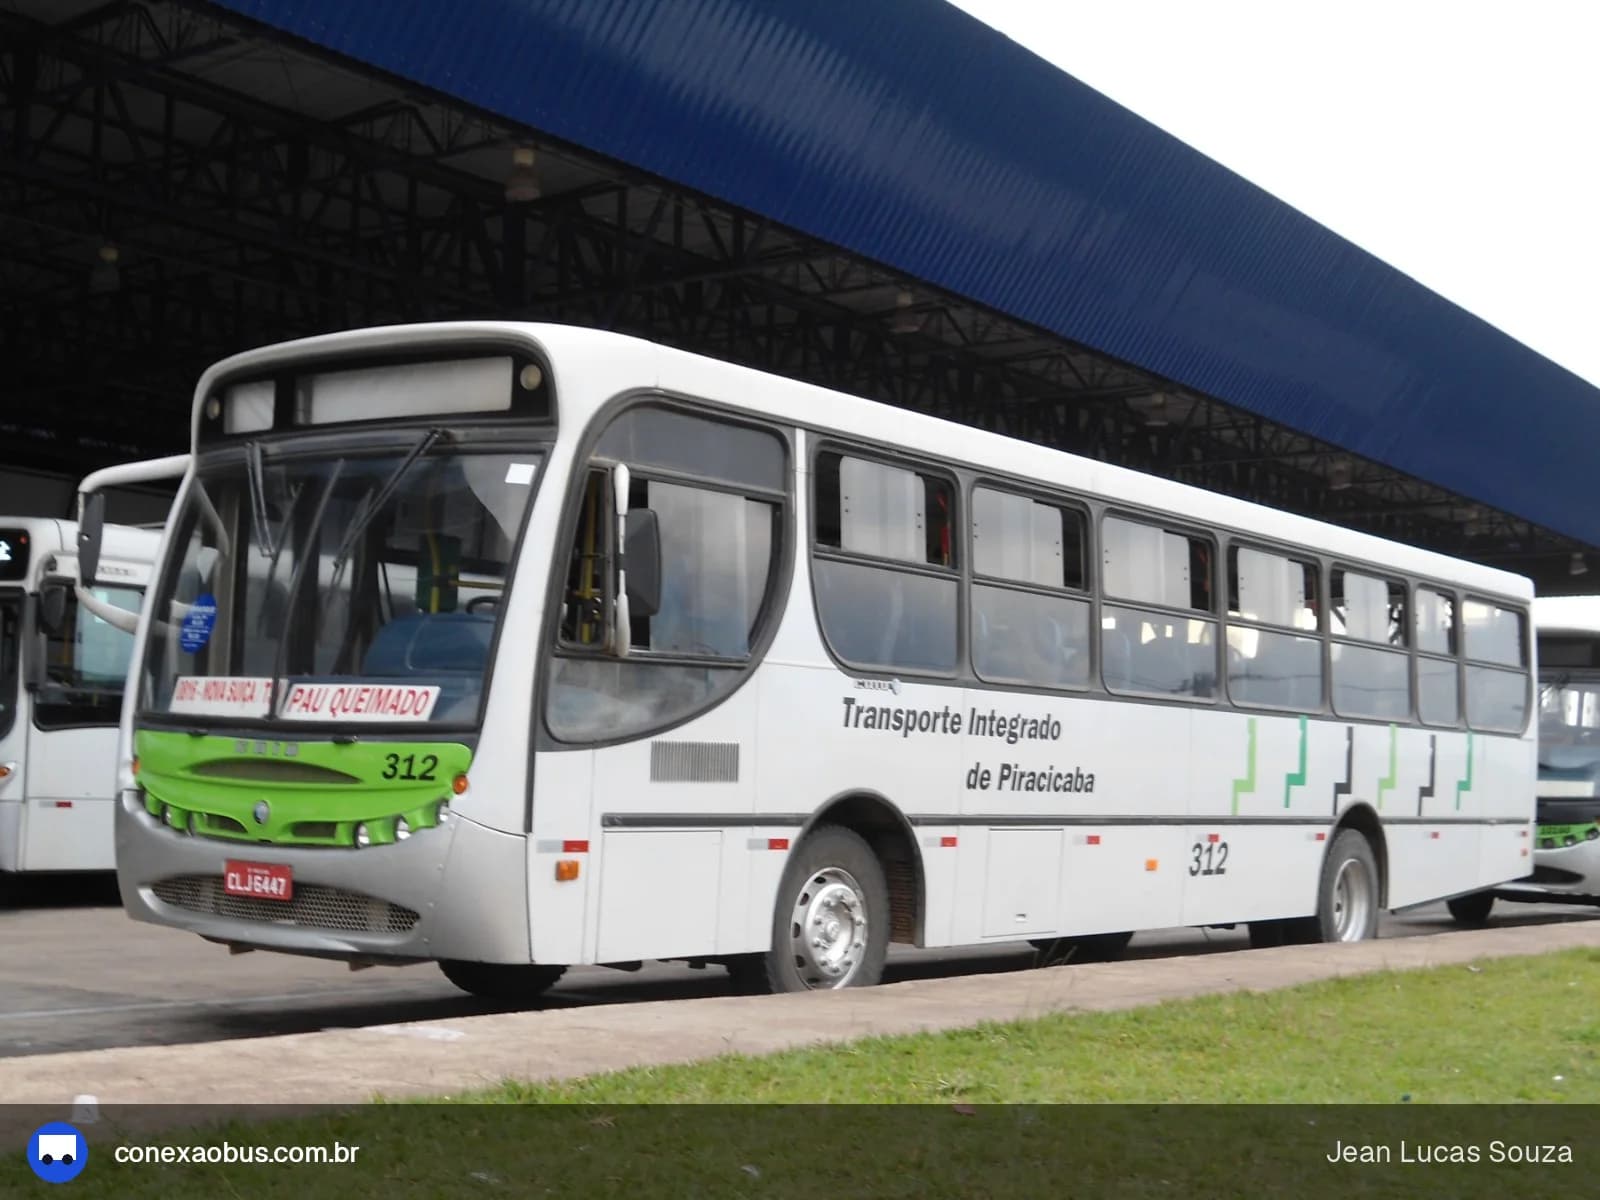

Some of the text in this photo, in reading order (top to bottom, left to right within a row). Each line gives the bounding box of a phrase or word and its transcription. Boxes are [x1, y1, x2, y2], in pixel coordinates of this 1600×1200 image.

[289, 688, 325, 713] PAU
[330, 689, 430, 717] QUEIMADO
[842, 697, 1062, 745] Transporte Integrado
[381, 753, 438, 781] 312
[966, 762, 1095, 793] de Piracicaba
[1189, 842, 1228, 877] 312
